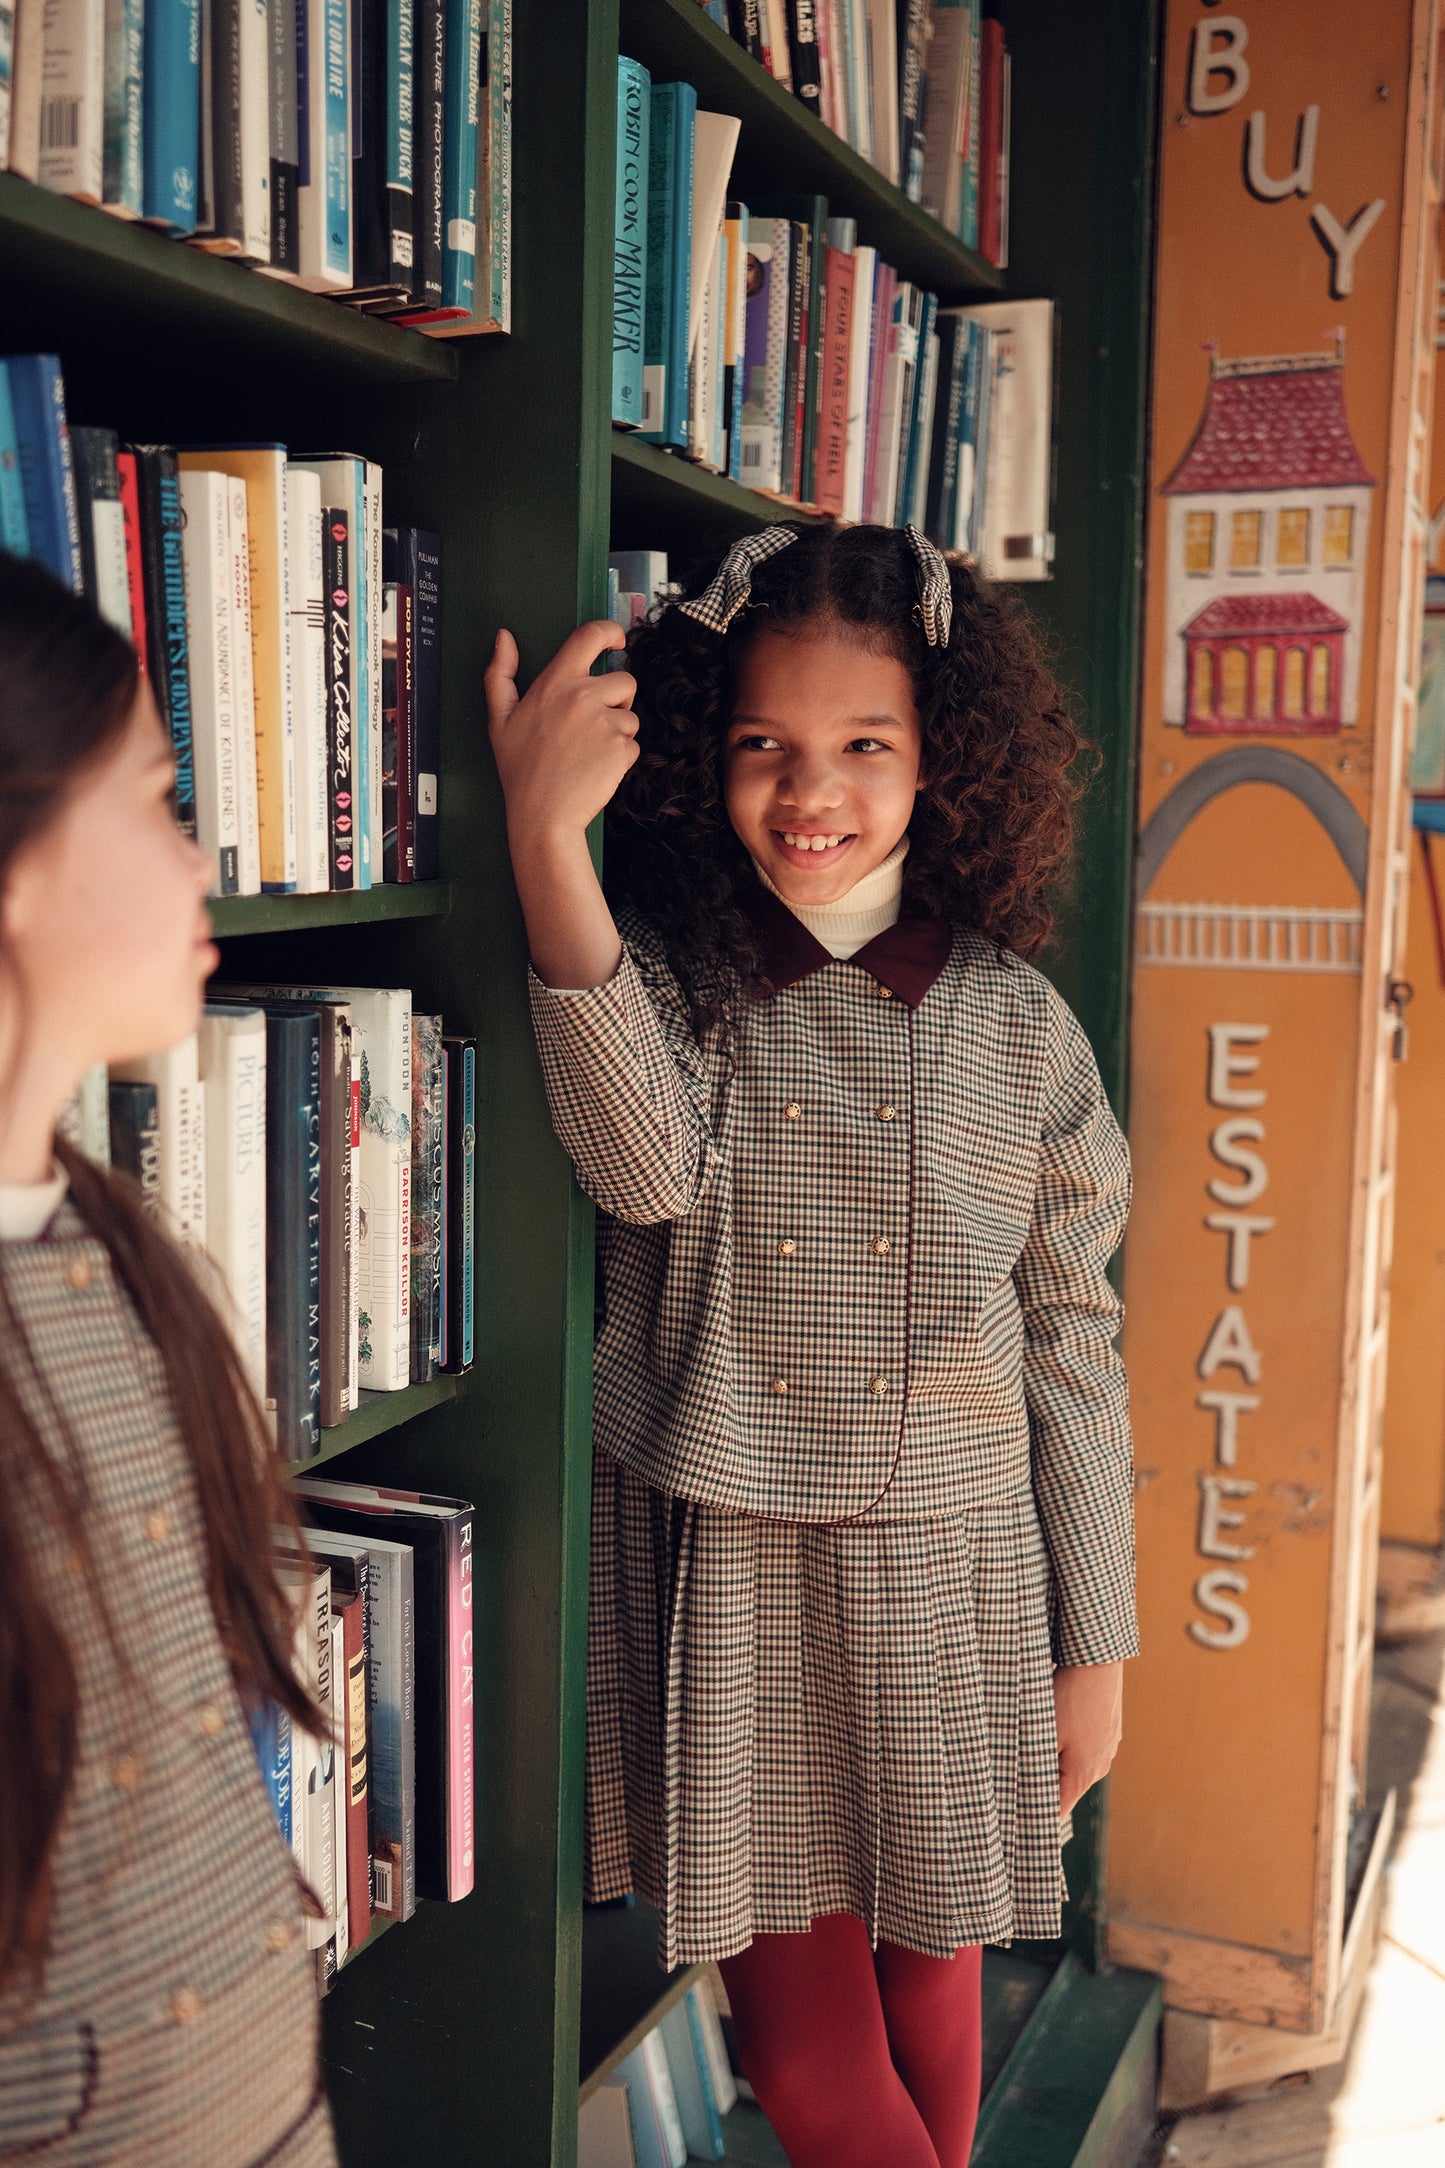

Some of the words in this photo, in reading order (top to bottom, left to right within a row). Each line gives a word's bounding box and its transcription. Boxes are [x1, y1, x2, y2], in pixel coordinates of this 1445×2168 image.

[434, 12, 442, 93] NATURE
[468, 31, 481, 126] Handbook
[399, 72, 411, 125] TREE
[624, 74, 642, 157] ROBIN
[398, 127, 412, 181] DUCK
[433, 101, 442, 250] PHOTOGRAPHY
[623, 162, 640, 233] COOK
[613, 238, 643, 354] MARKER
[836, 286, 850, 336] FOUR
[832, 342, 848, 398] STARS
[830, 405, 845, 429] OF
[826, 435, 843, 477] HELL
[372, 493, 380, 523] The
[418, 551, 439, 566] PULLMAN
[419, 579, 438, 592] GOLDEN
[372, 528, 381, 672] Kosher-Cookbook
[419, 591, 438, 604] COMPASS
[332, 610, 350, 680] Kiss
[405, 637, 413, 690] DYLAN
[333, 680, 352, 790] Collector
[371, 678, 381, 731] Trilogy
[221, 735, 236, 832] KATHERINES
[401, 1011, 410, 1092] PONTOON
[236, 1055, 258, 1175] PICTURES
[341, 1106, 352, 1177] Saving
[308, 1113, 322, 1227] CARVE
[344, 1182, 352, 1252] Gracie
[401, 1167, 411, 1247] GARRISON
[309, 1237, 321, 1289] THE
[432, 1210, 443, 1291] MASK
[401, 1253, 411, 1317] KEILLOR
[307, 1303, 321, 1400] MARK
[1188, 1022, 1277, 1649] ESTATES
[360, 1564, 368, 1582] The
[459, 1521, 473, 1609] RED
[403, 1598, 412, 1618] For
[316, 1586, 331, 1705] TREASON
[403, 1641, 412, 1670] Love
[403, 1672, 411, 1685] of
[460, 1630, 473, 1708] CAT
[403, 1686, 412, 1721] Beirut
[463, 1723, 472, 1762] PETER
[270, 1764, 291, 1808] JOB
[320, 1801, 332, 1838] ANN
[462, 1767, 472, 1847] SPIEGELMAN
[404, 1818, 413, 1860] Samuel
